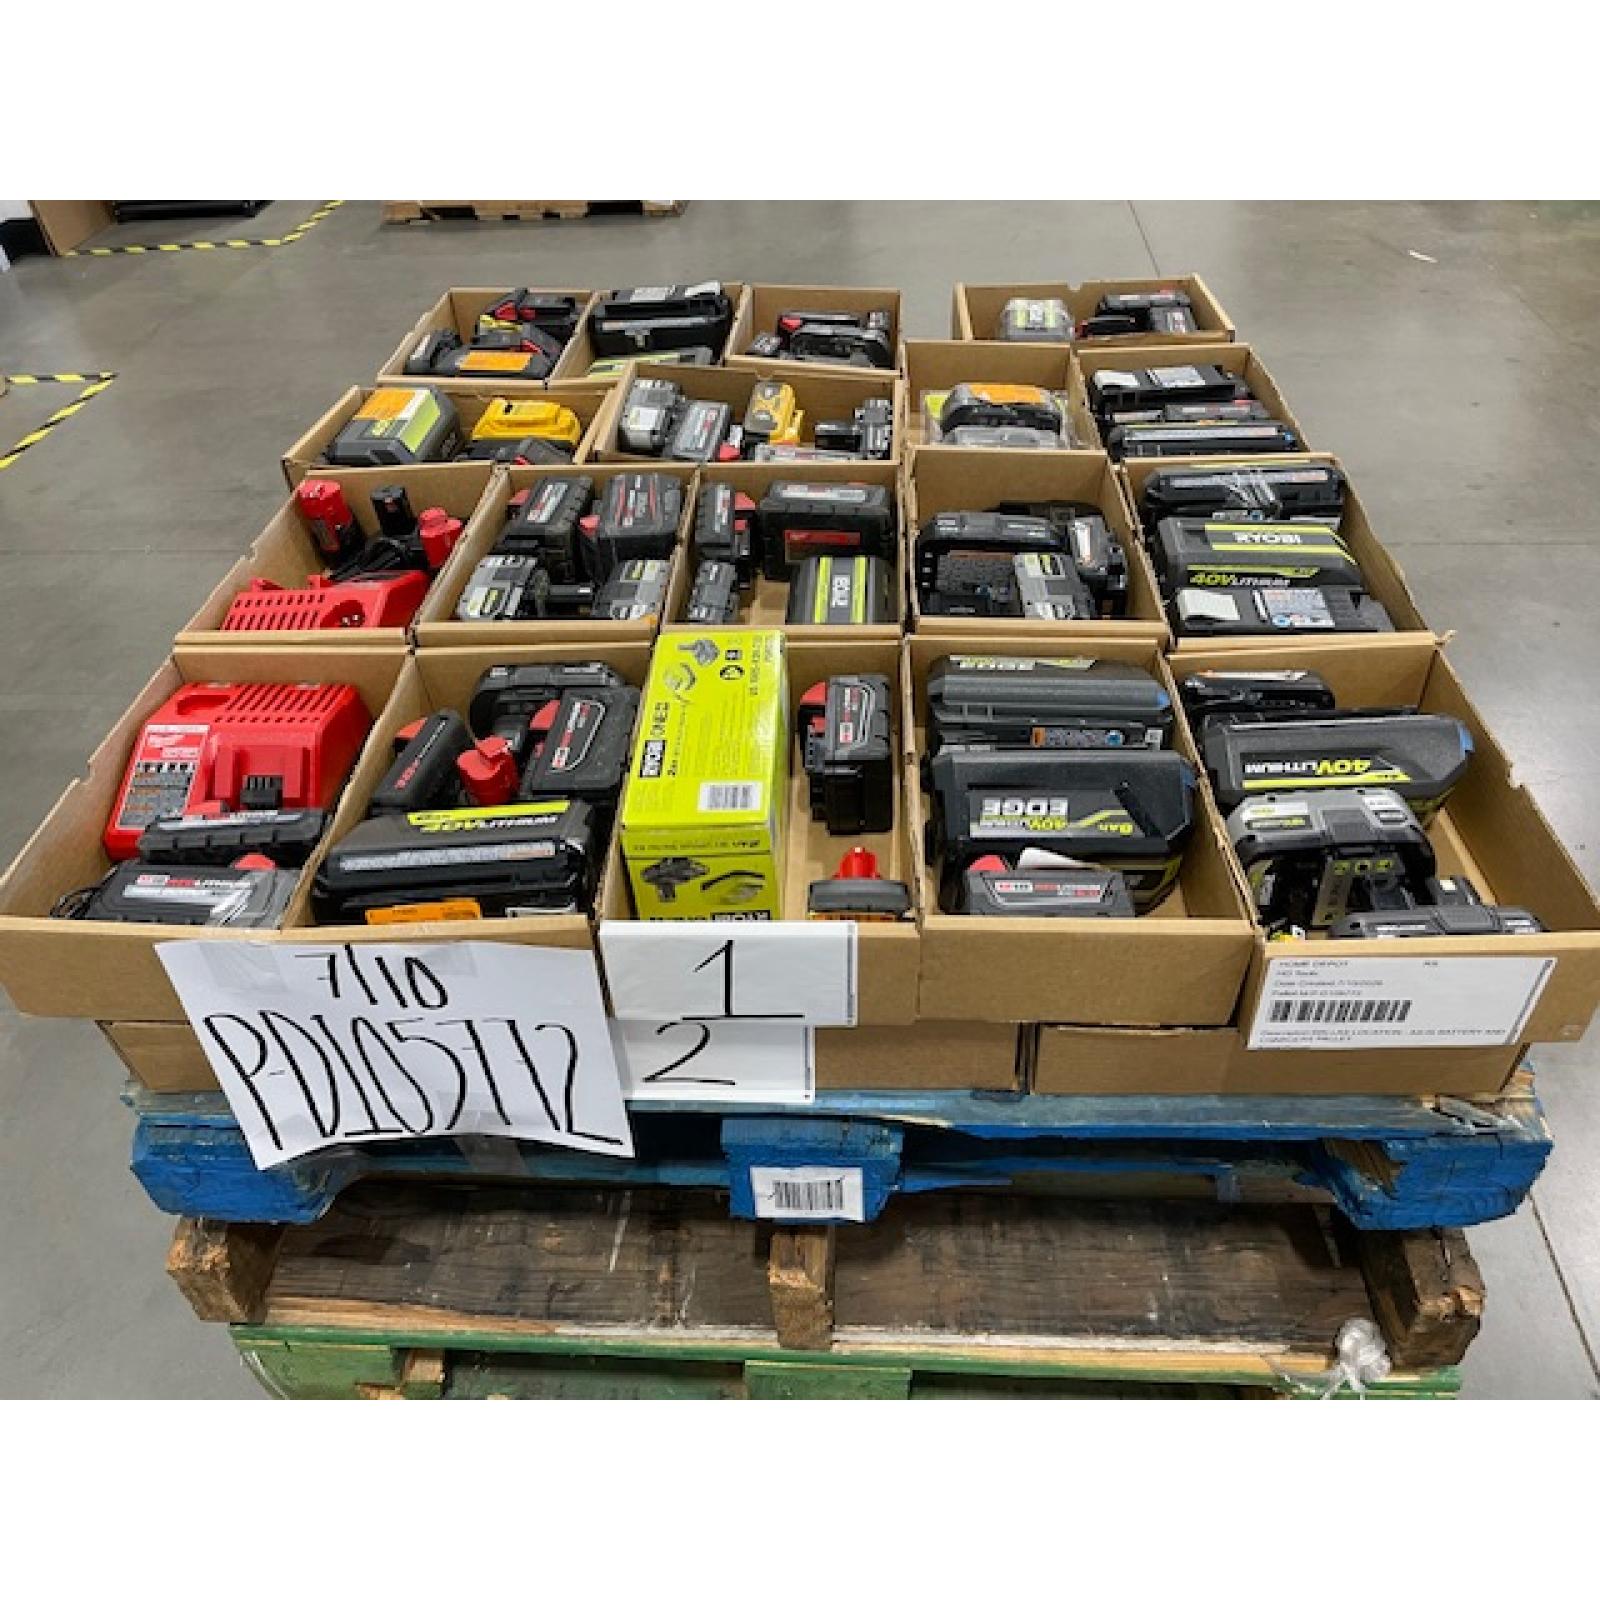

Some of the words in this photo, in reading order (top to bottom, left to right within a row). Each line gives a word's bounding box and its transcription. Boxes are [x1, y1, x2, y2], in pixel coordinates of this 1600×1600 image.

[981, 797, 1068, 816] EDGE
[295, 940, 449, 1011] 7/10
[683, 940, 804, 1021] 1
[642, 1021, 735, 1086] 2
